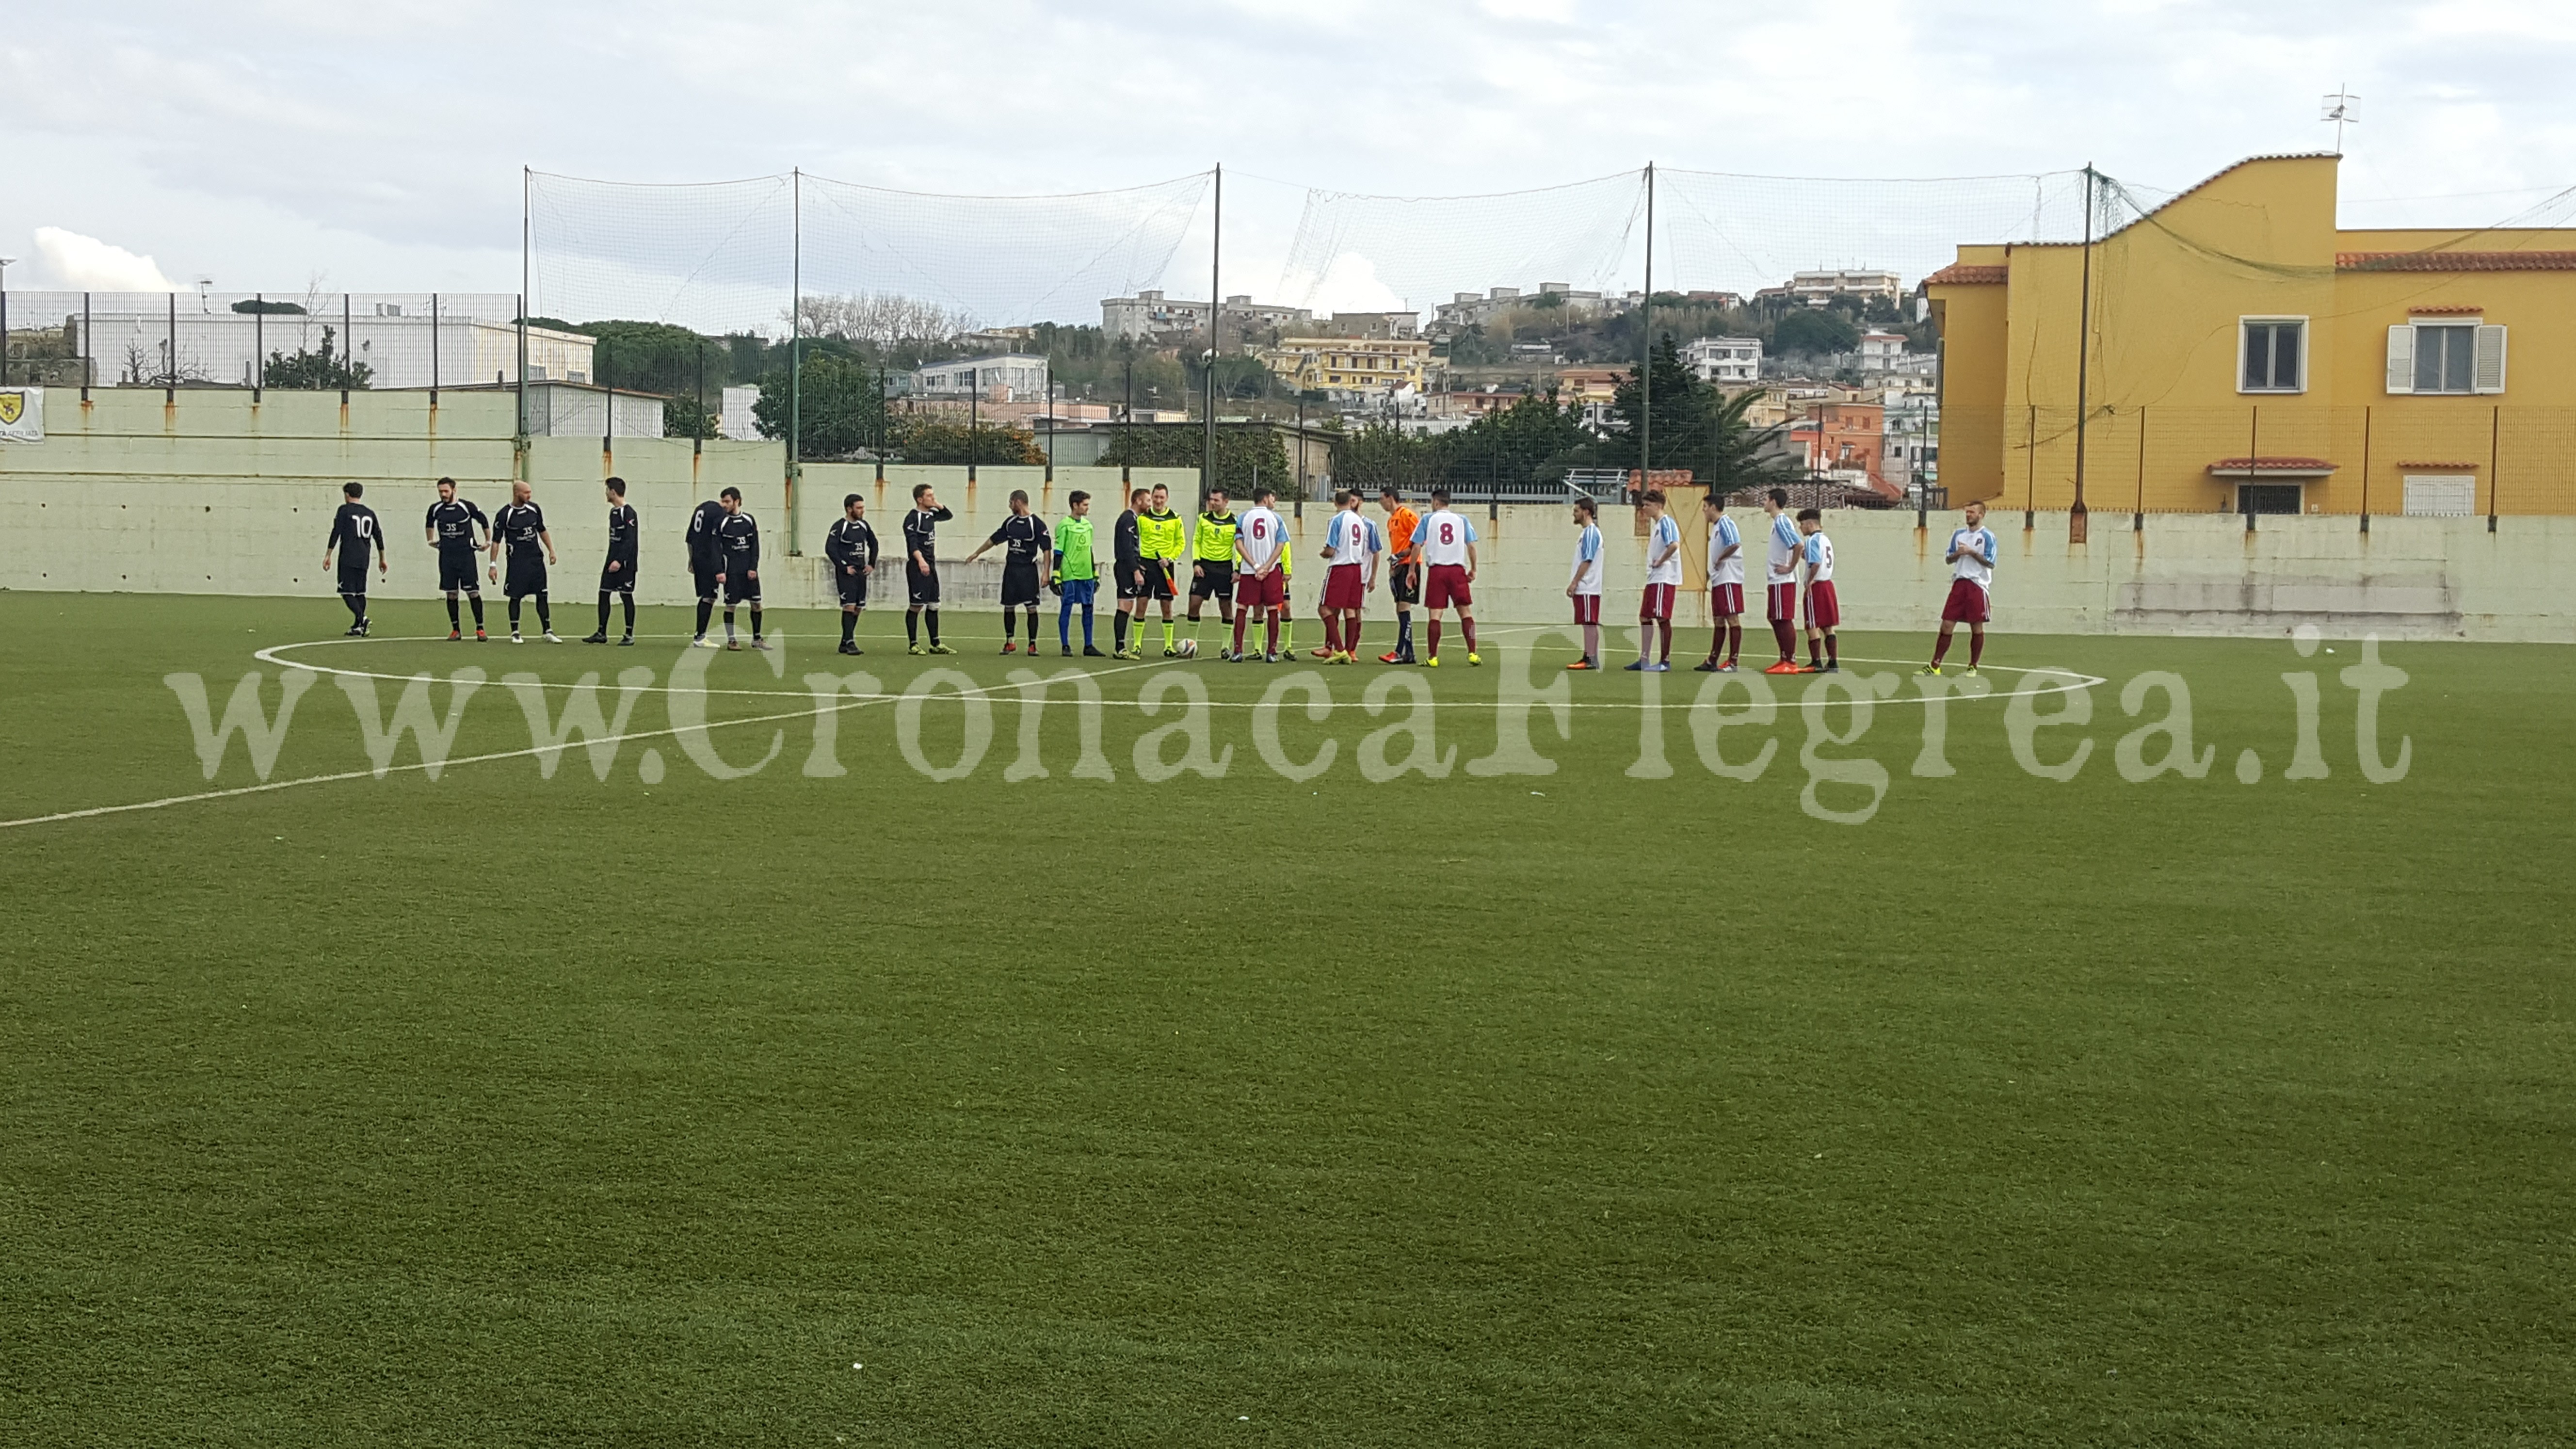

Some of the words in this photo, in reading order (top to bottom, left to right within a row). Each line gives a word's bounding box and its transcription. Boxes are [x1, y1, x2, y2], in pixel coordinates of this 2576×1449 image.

[352, 515, 372, 538] 10
[694, 509, 704, 532] 6
[1253, 518, 1265, 540] 6
[1352, 524, 1361, 546] 9
[1440, 523, 1453, 545] 8
[1825, 546, 1832, 569] 5
